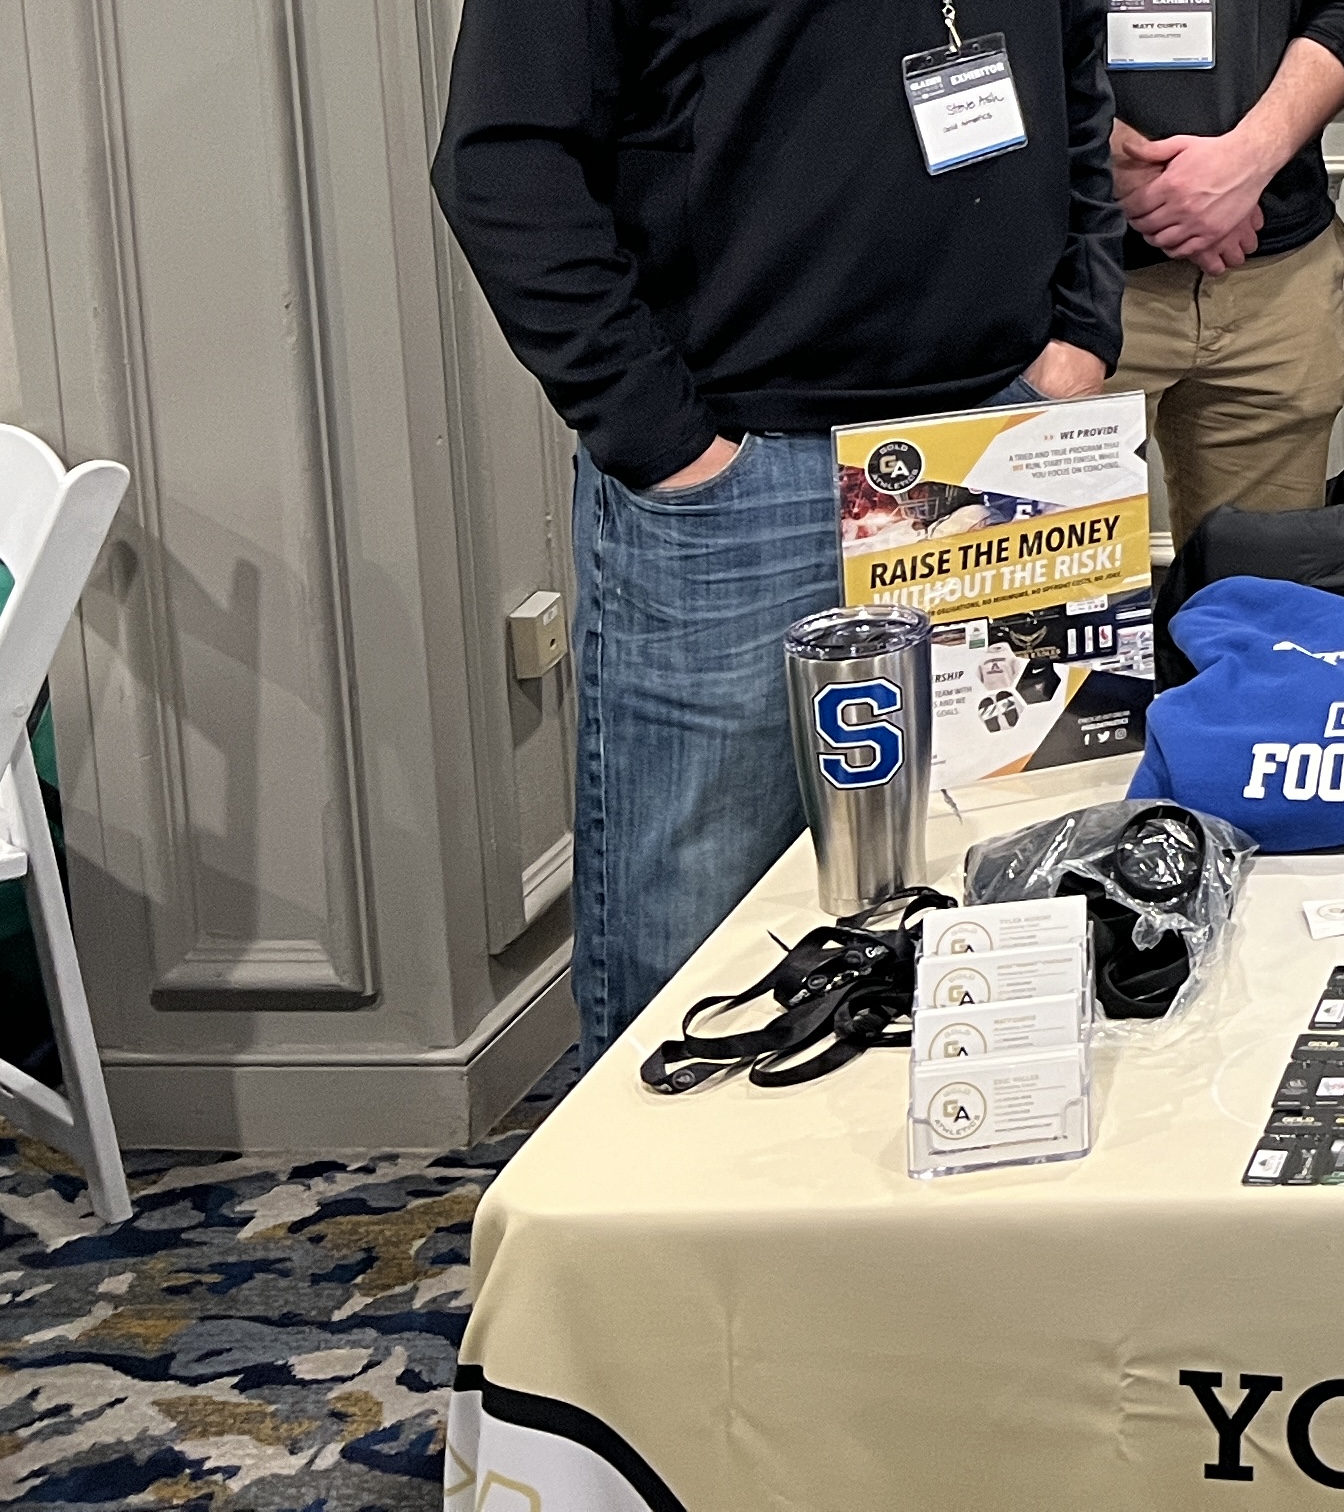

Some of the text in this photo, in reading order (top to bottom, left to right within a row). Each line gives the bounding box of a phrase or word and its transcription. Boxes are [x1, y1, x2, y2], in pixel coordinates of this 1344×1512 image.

[950, 61, 1005, 86] EXHIBITOR
[1060, 425, 1120, 440] WE PROVIDE
[879, 444, 908, 455] GOLD
[879, 454, 910, 478] GA
[870, 514, 1121, 591] RAISE THE MONEY
[873, 542, 1123, 611] WITHOUT THE RISK!
[935, 686, 972, 699] TEAM WITH
[813, 676, 905, 791] S
[942, 1099, 971, 1124] GA
